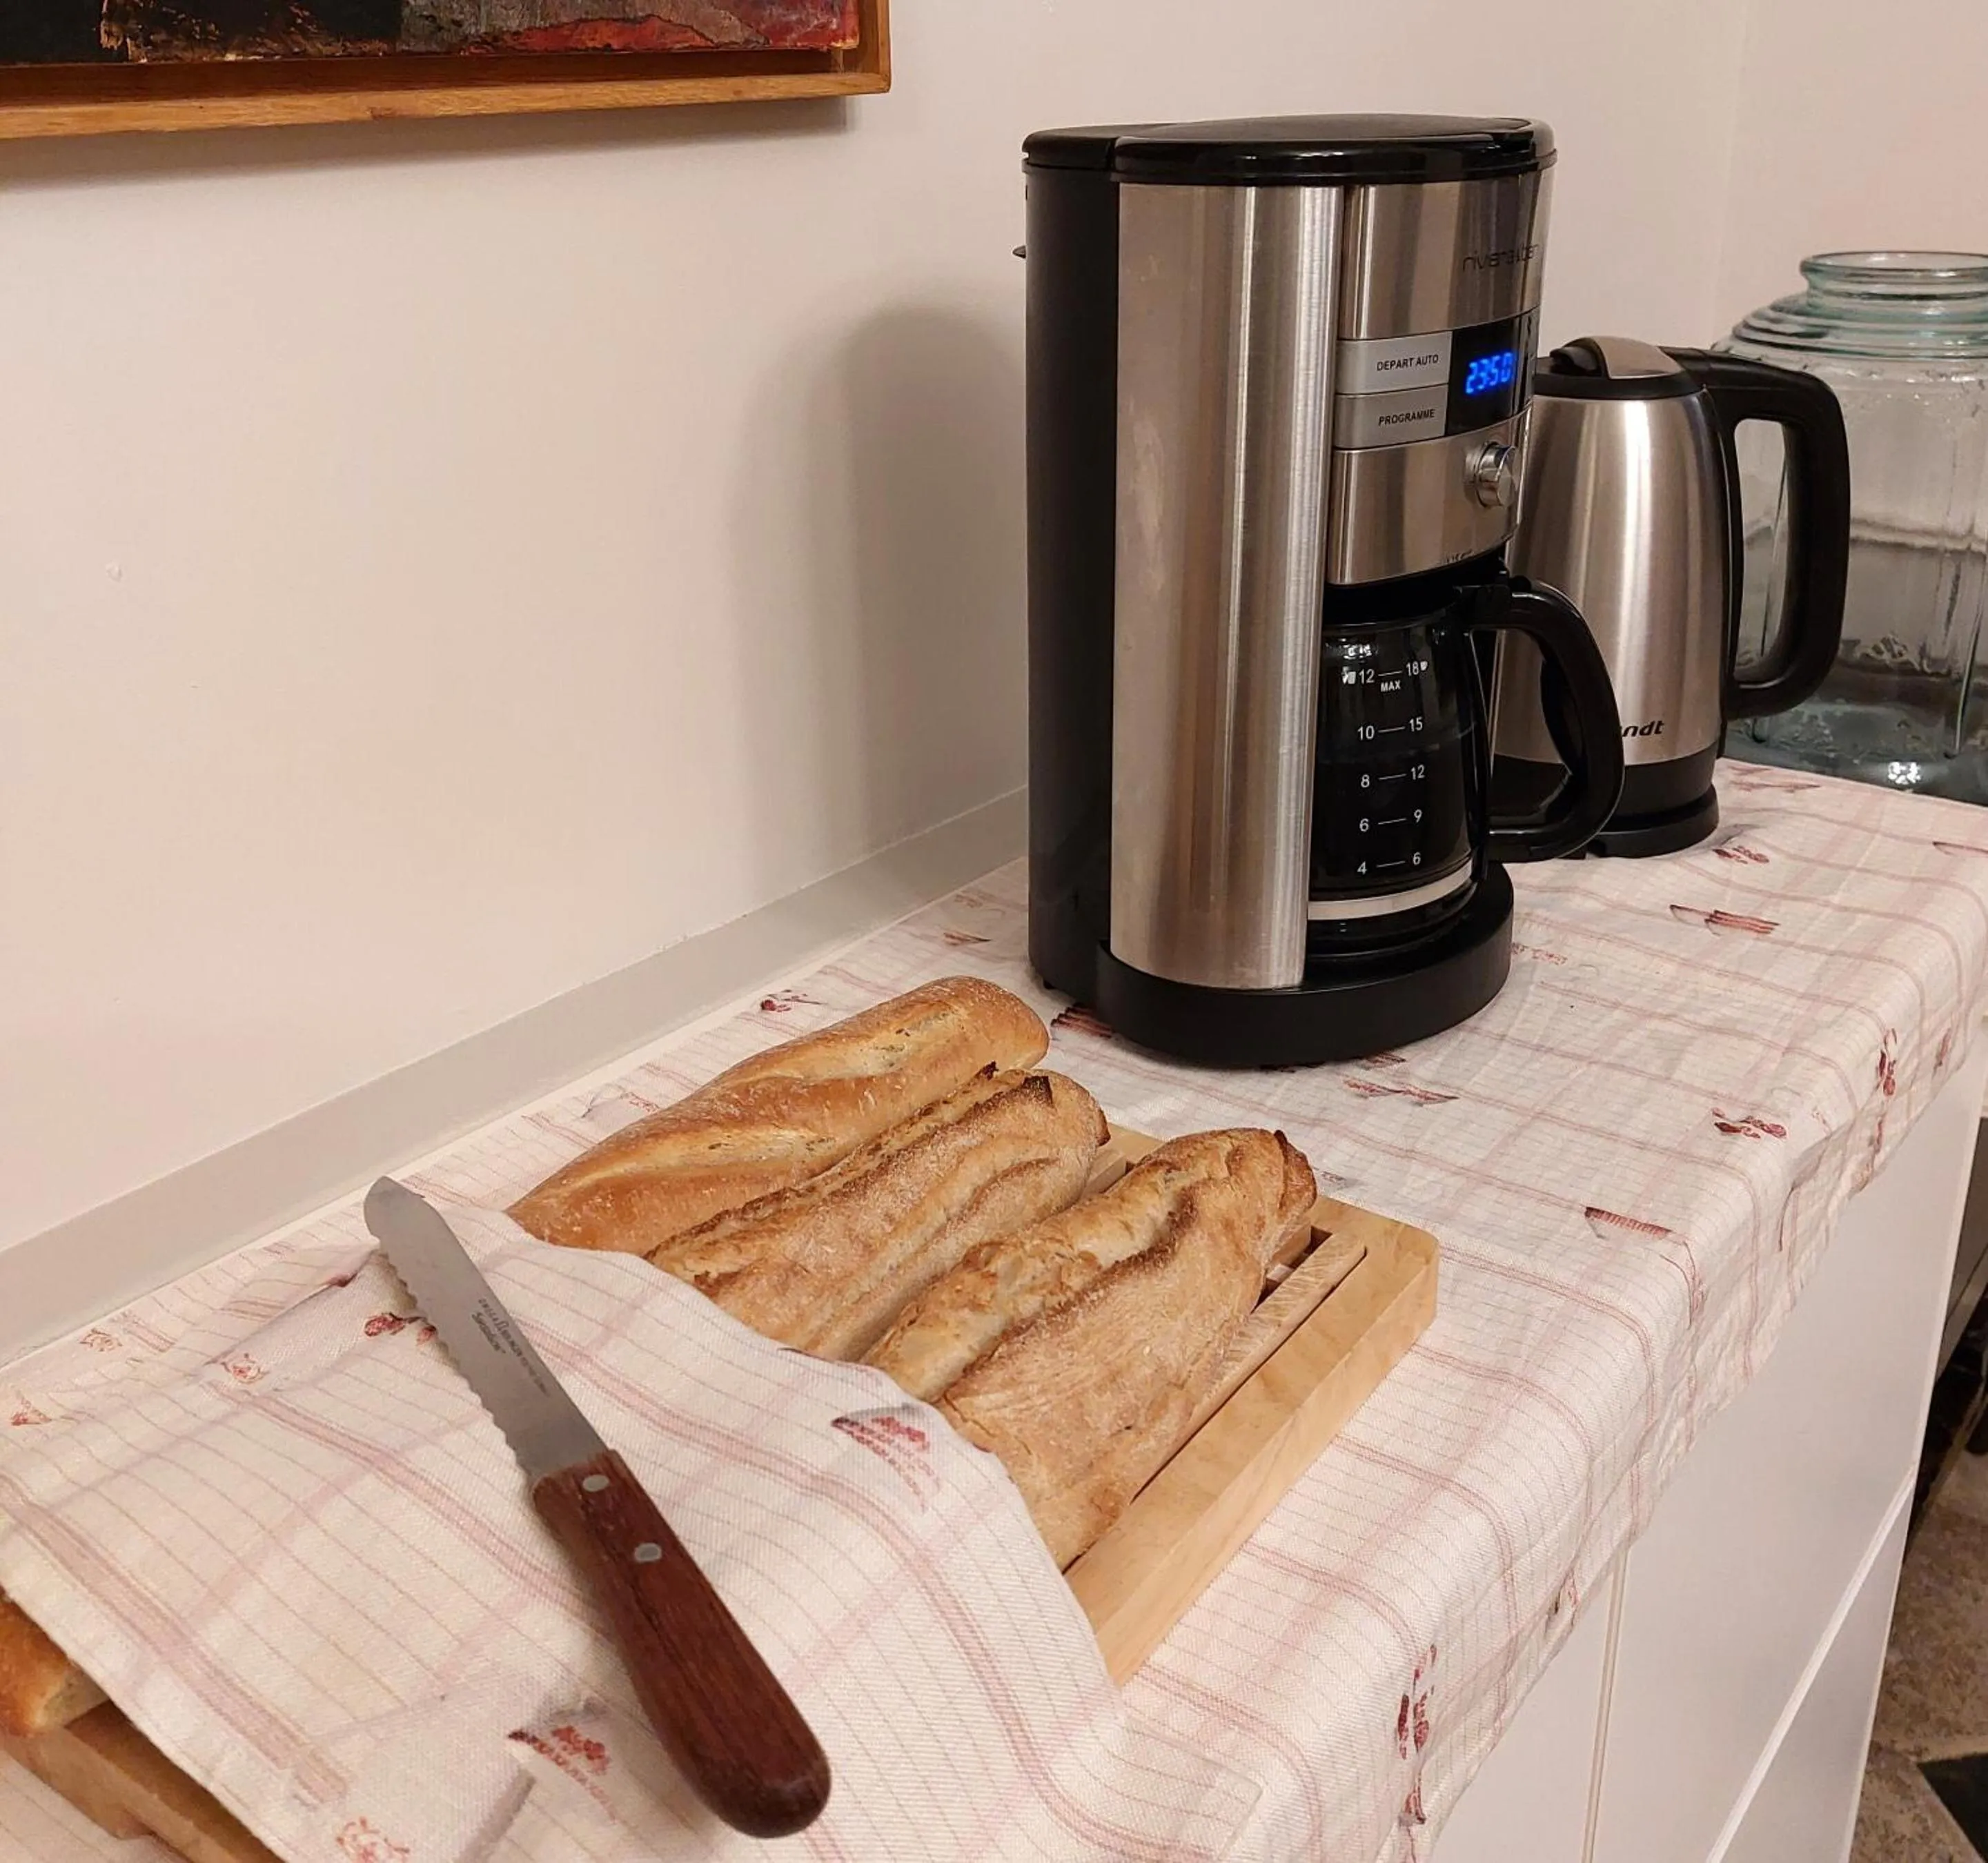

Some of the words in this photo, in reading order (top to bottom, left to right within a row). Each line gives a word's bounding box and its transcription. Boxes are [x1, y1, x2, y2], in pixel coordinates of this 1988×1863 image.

[1377, 357, 1415, 371] DEPART
[1416, 354, 1439, 366] AUTO
[1378, 408, 1435, 426] PROGRAMME
[1359, 669, 1375, 684] 12
[1406, 660, 1419, 676] 18
[1380, 680, 1401, 692] MAX
[1357, 725, 1375, 740] 10
[1409, 716, 1423, 731] 15
[1622, 720, 1664, 737] ndt
[1361, 774, 1370, 787] 8
[1411, 765, 1426, 780] 12
[1359, 818, 1369, 831] 6
[1414, 809, 1422, 822] 9
[1357, 862, 1367, 875] 4
[1413, 852, 1421, 865] 6
